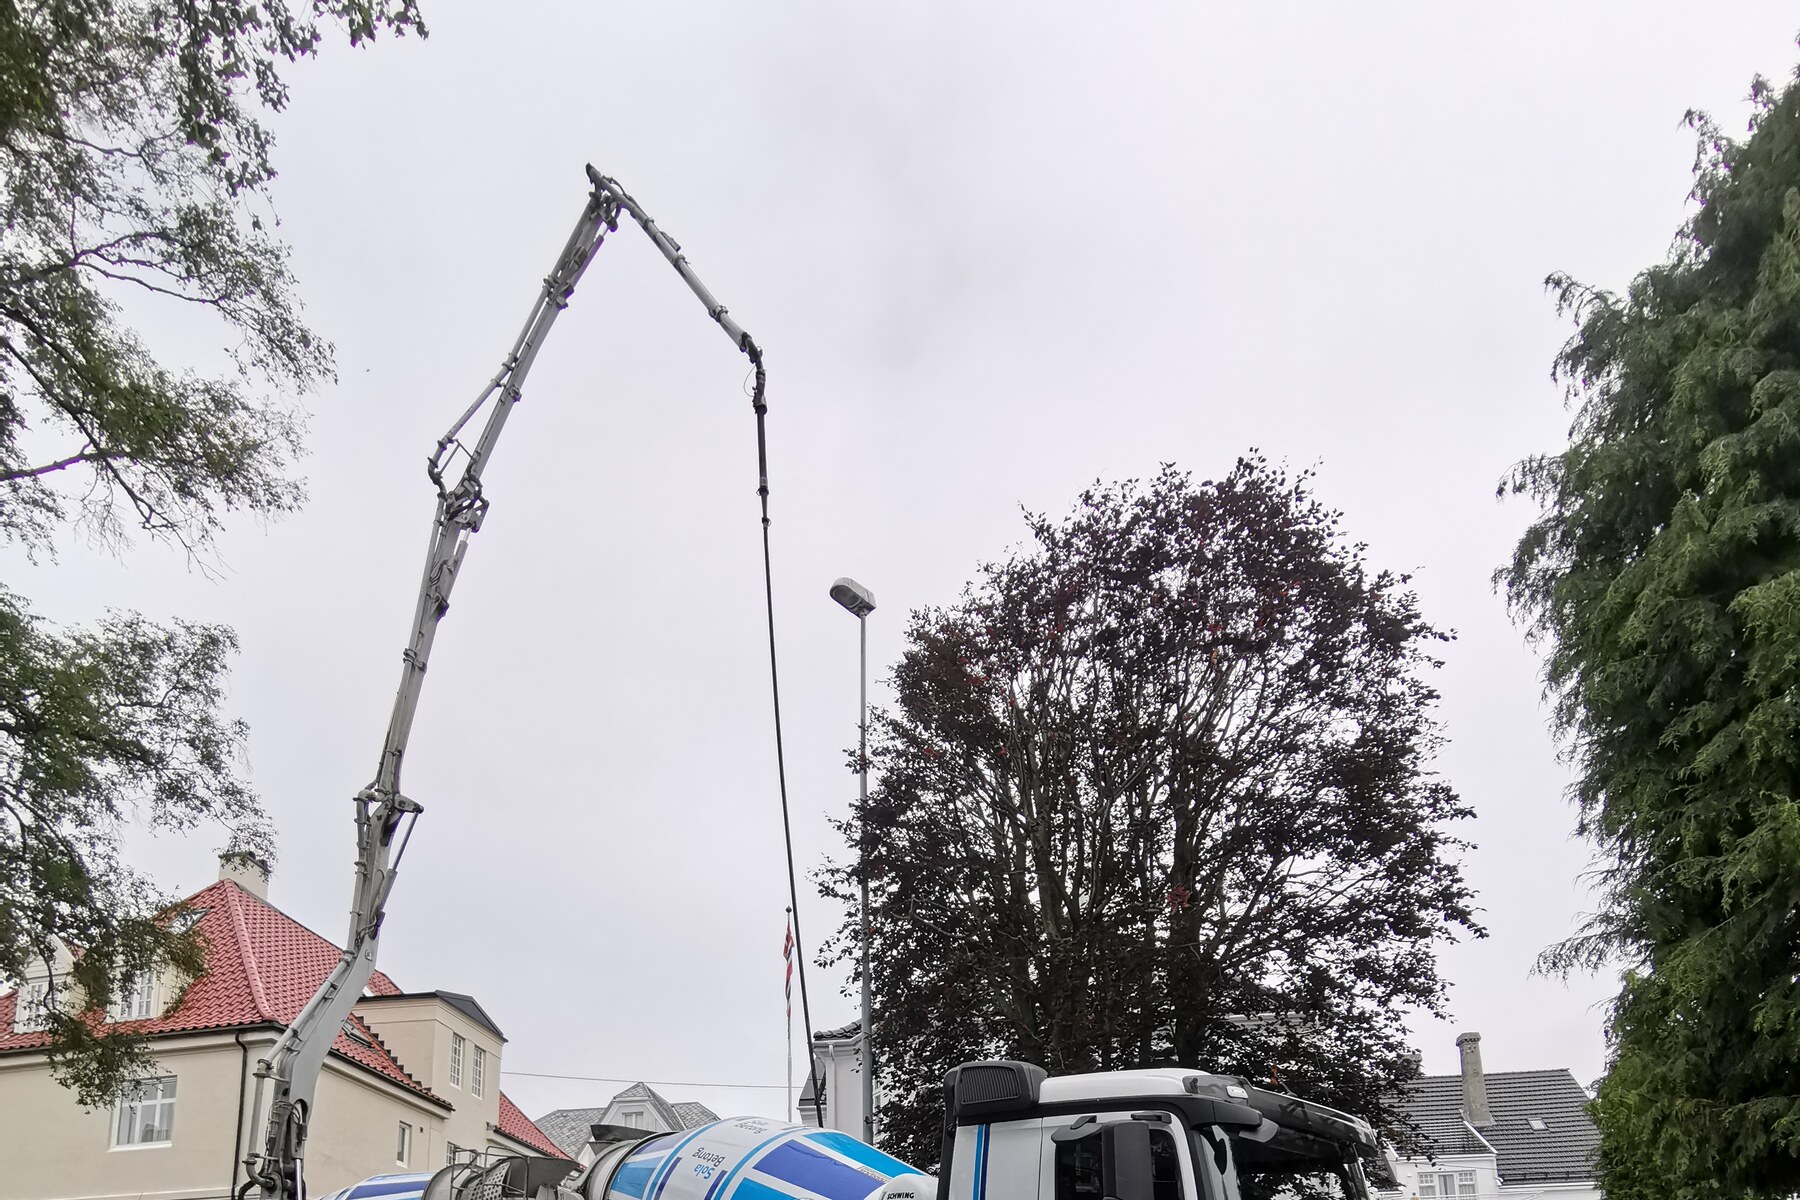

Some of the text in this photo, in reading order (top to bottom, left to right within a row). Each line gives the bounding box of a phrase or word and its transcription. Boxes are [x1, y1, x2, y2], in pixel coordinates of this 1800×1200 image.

[692, 1147, 726, 1167] Betong
[694, 1164, 715, 1179] Sola
[887, 1192, 914, 1200] SCHWING
